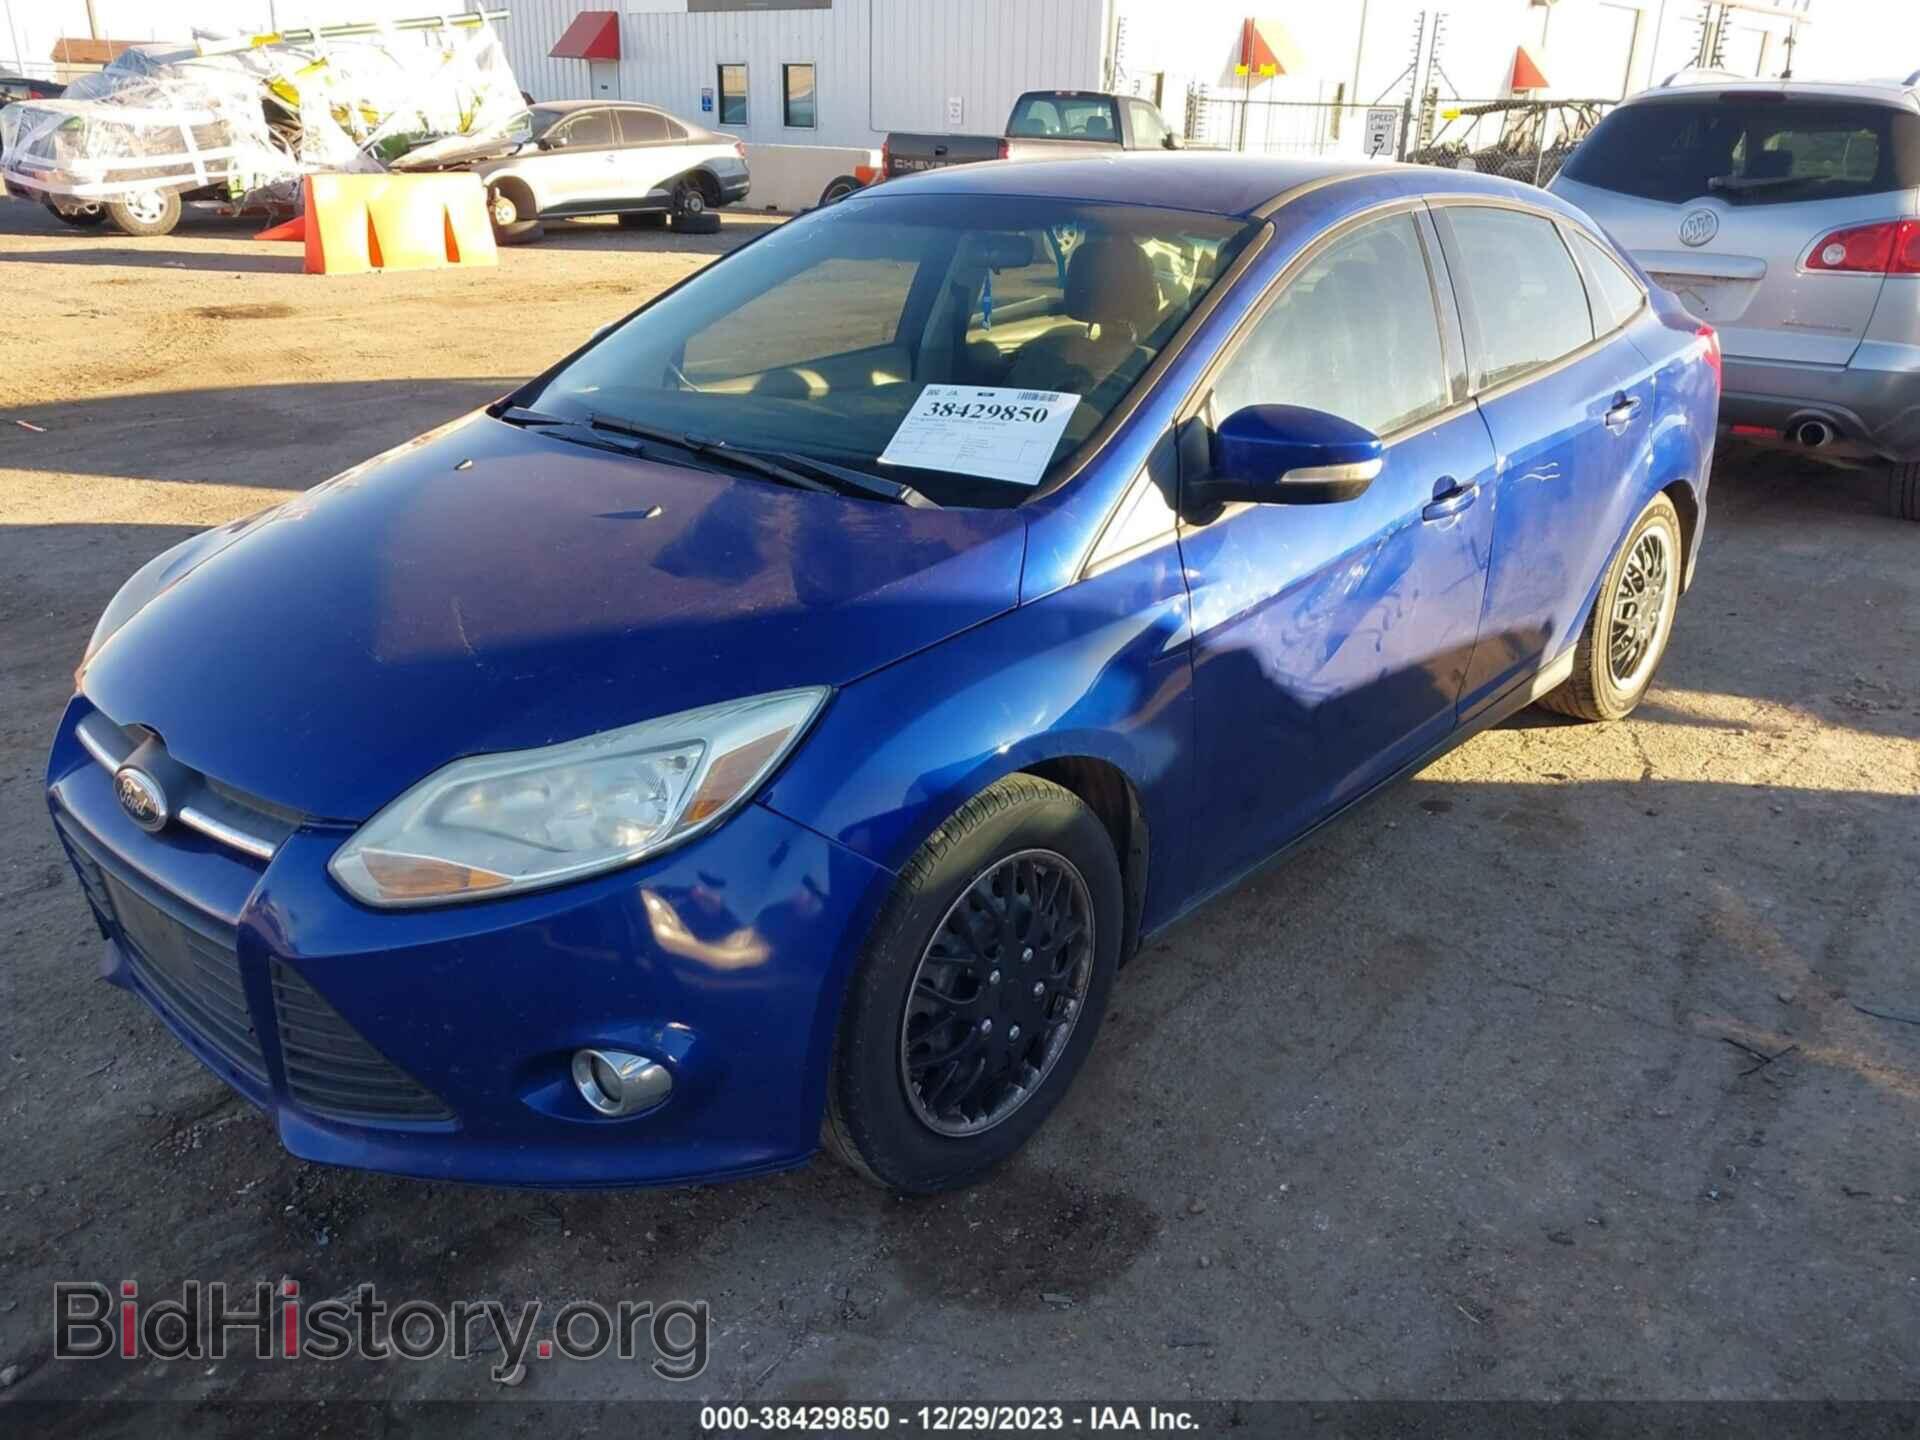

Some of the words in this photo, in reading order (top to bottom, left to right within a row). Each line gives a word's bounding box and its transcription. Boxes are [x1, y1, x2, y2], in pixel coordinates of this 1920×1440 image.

[1370, 113, 1393, 121] SPEED
[1370, 123, 1392, 131] LIMIT
[923, 402, 1049, 424] 38429850
